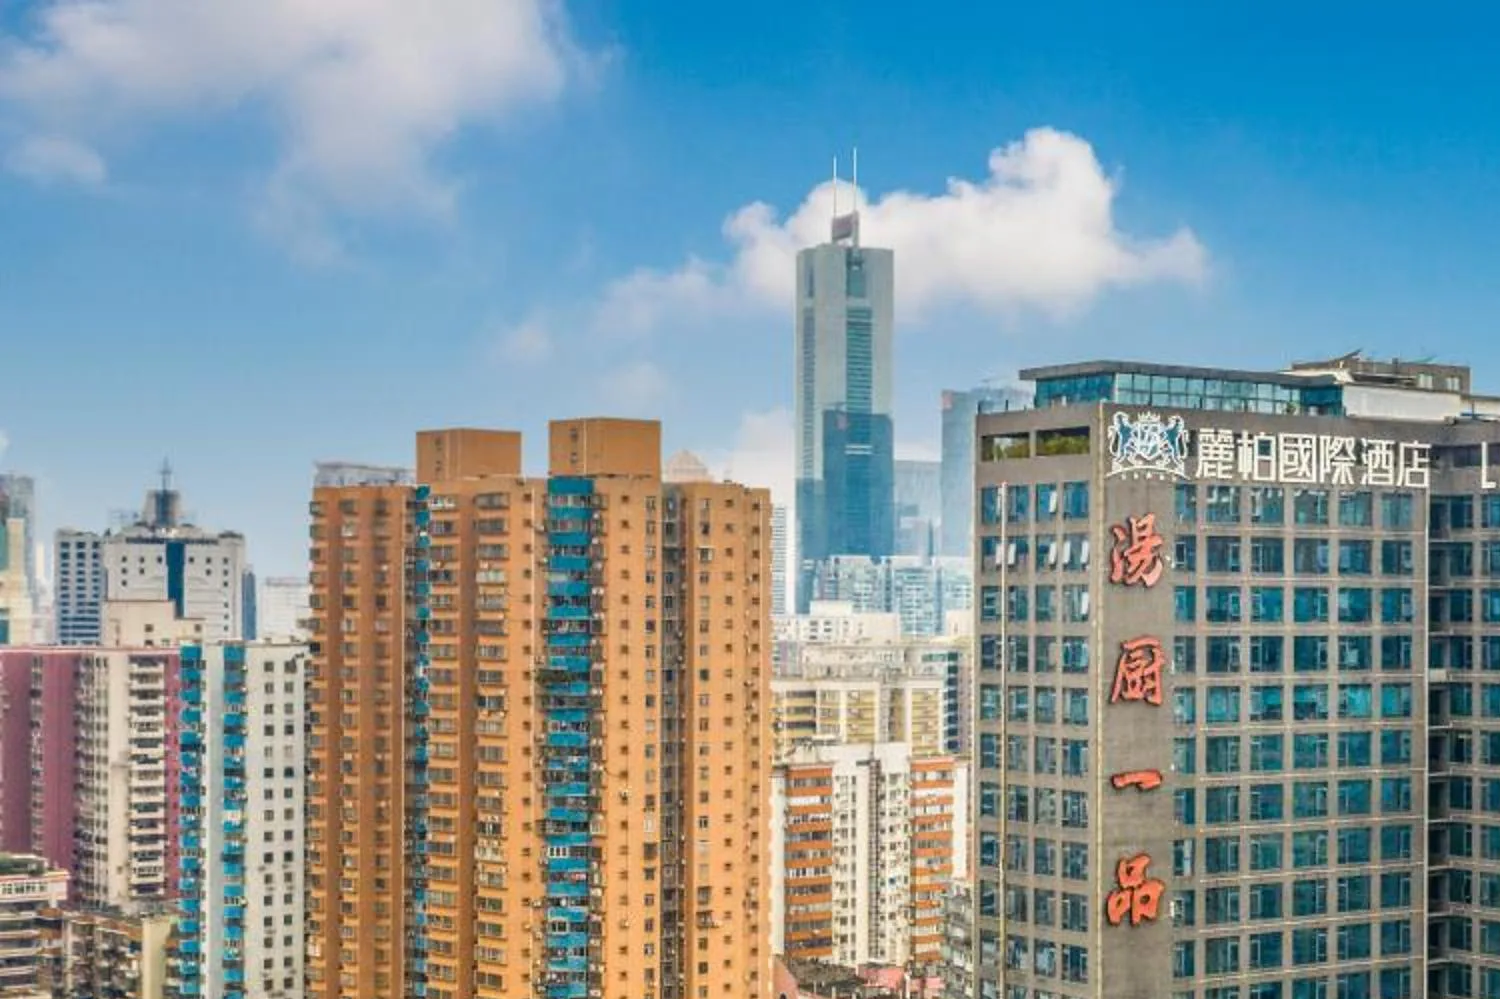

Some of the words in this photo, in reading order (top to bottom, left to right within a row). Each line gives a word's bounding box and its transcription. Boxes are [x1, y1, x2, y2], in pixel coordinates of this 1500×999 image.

[1195, 427, 1431, 488] 麗柏國際酒店
